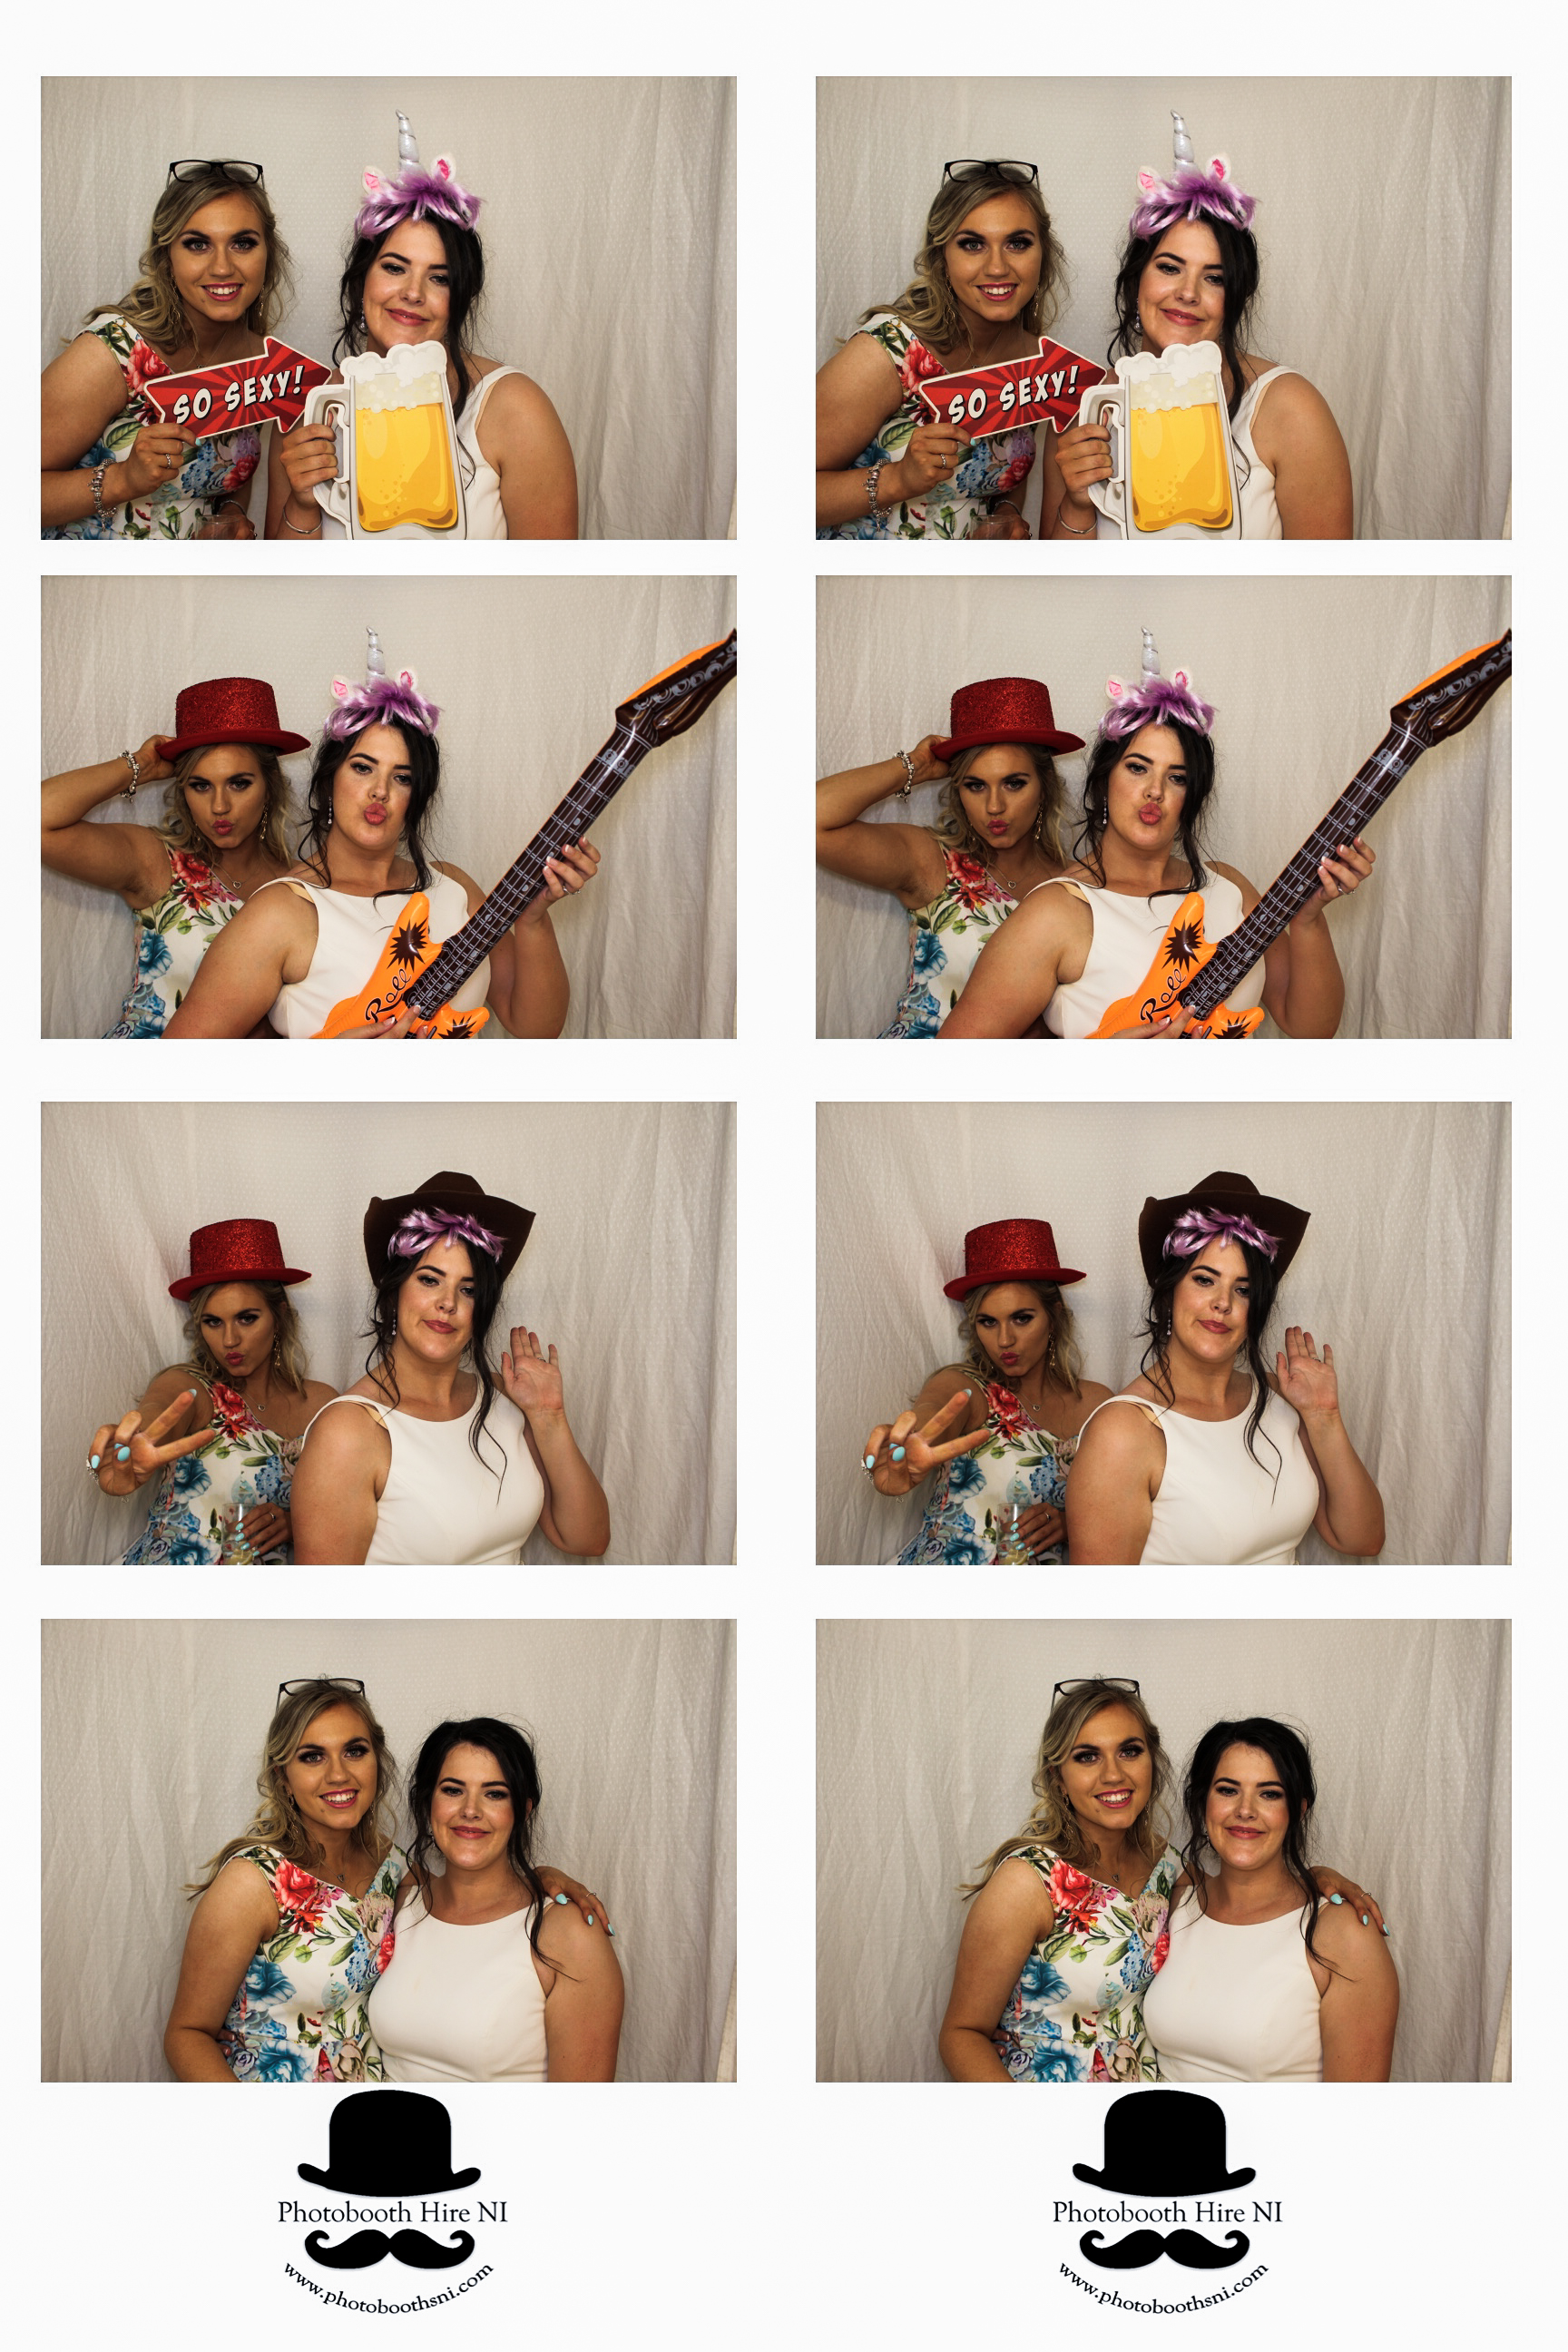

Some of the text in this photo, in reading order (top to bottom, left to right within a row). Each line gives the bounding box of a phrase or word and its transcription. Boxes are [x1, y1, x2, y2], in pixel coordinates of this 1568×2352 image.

[172, 365, 305, 425] SO SEXY!
[947, 365, 1080, 425] SO SEXY!
[364, 967, 413, 1024] Roll
[1139, 967, 1188, 1024] Roll
